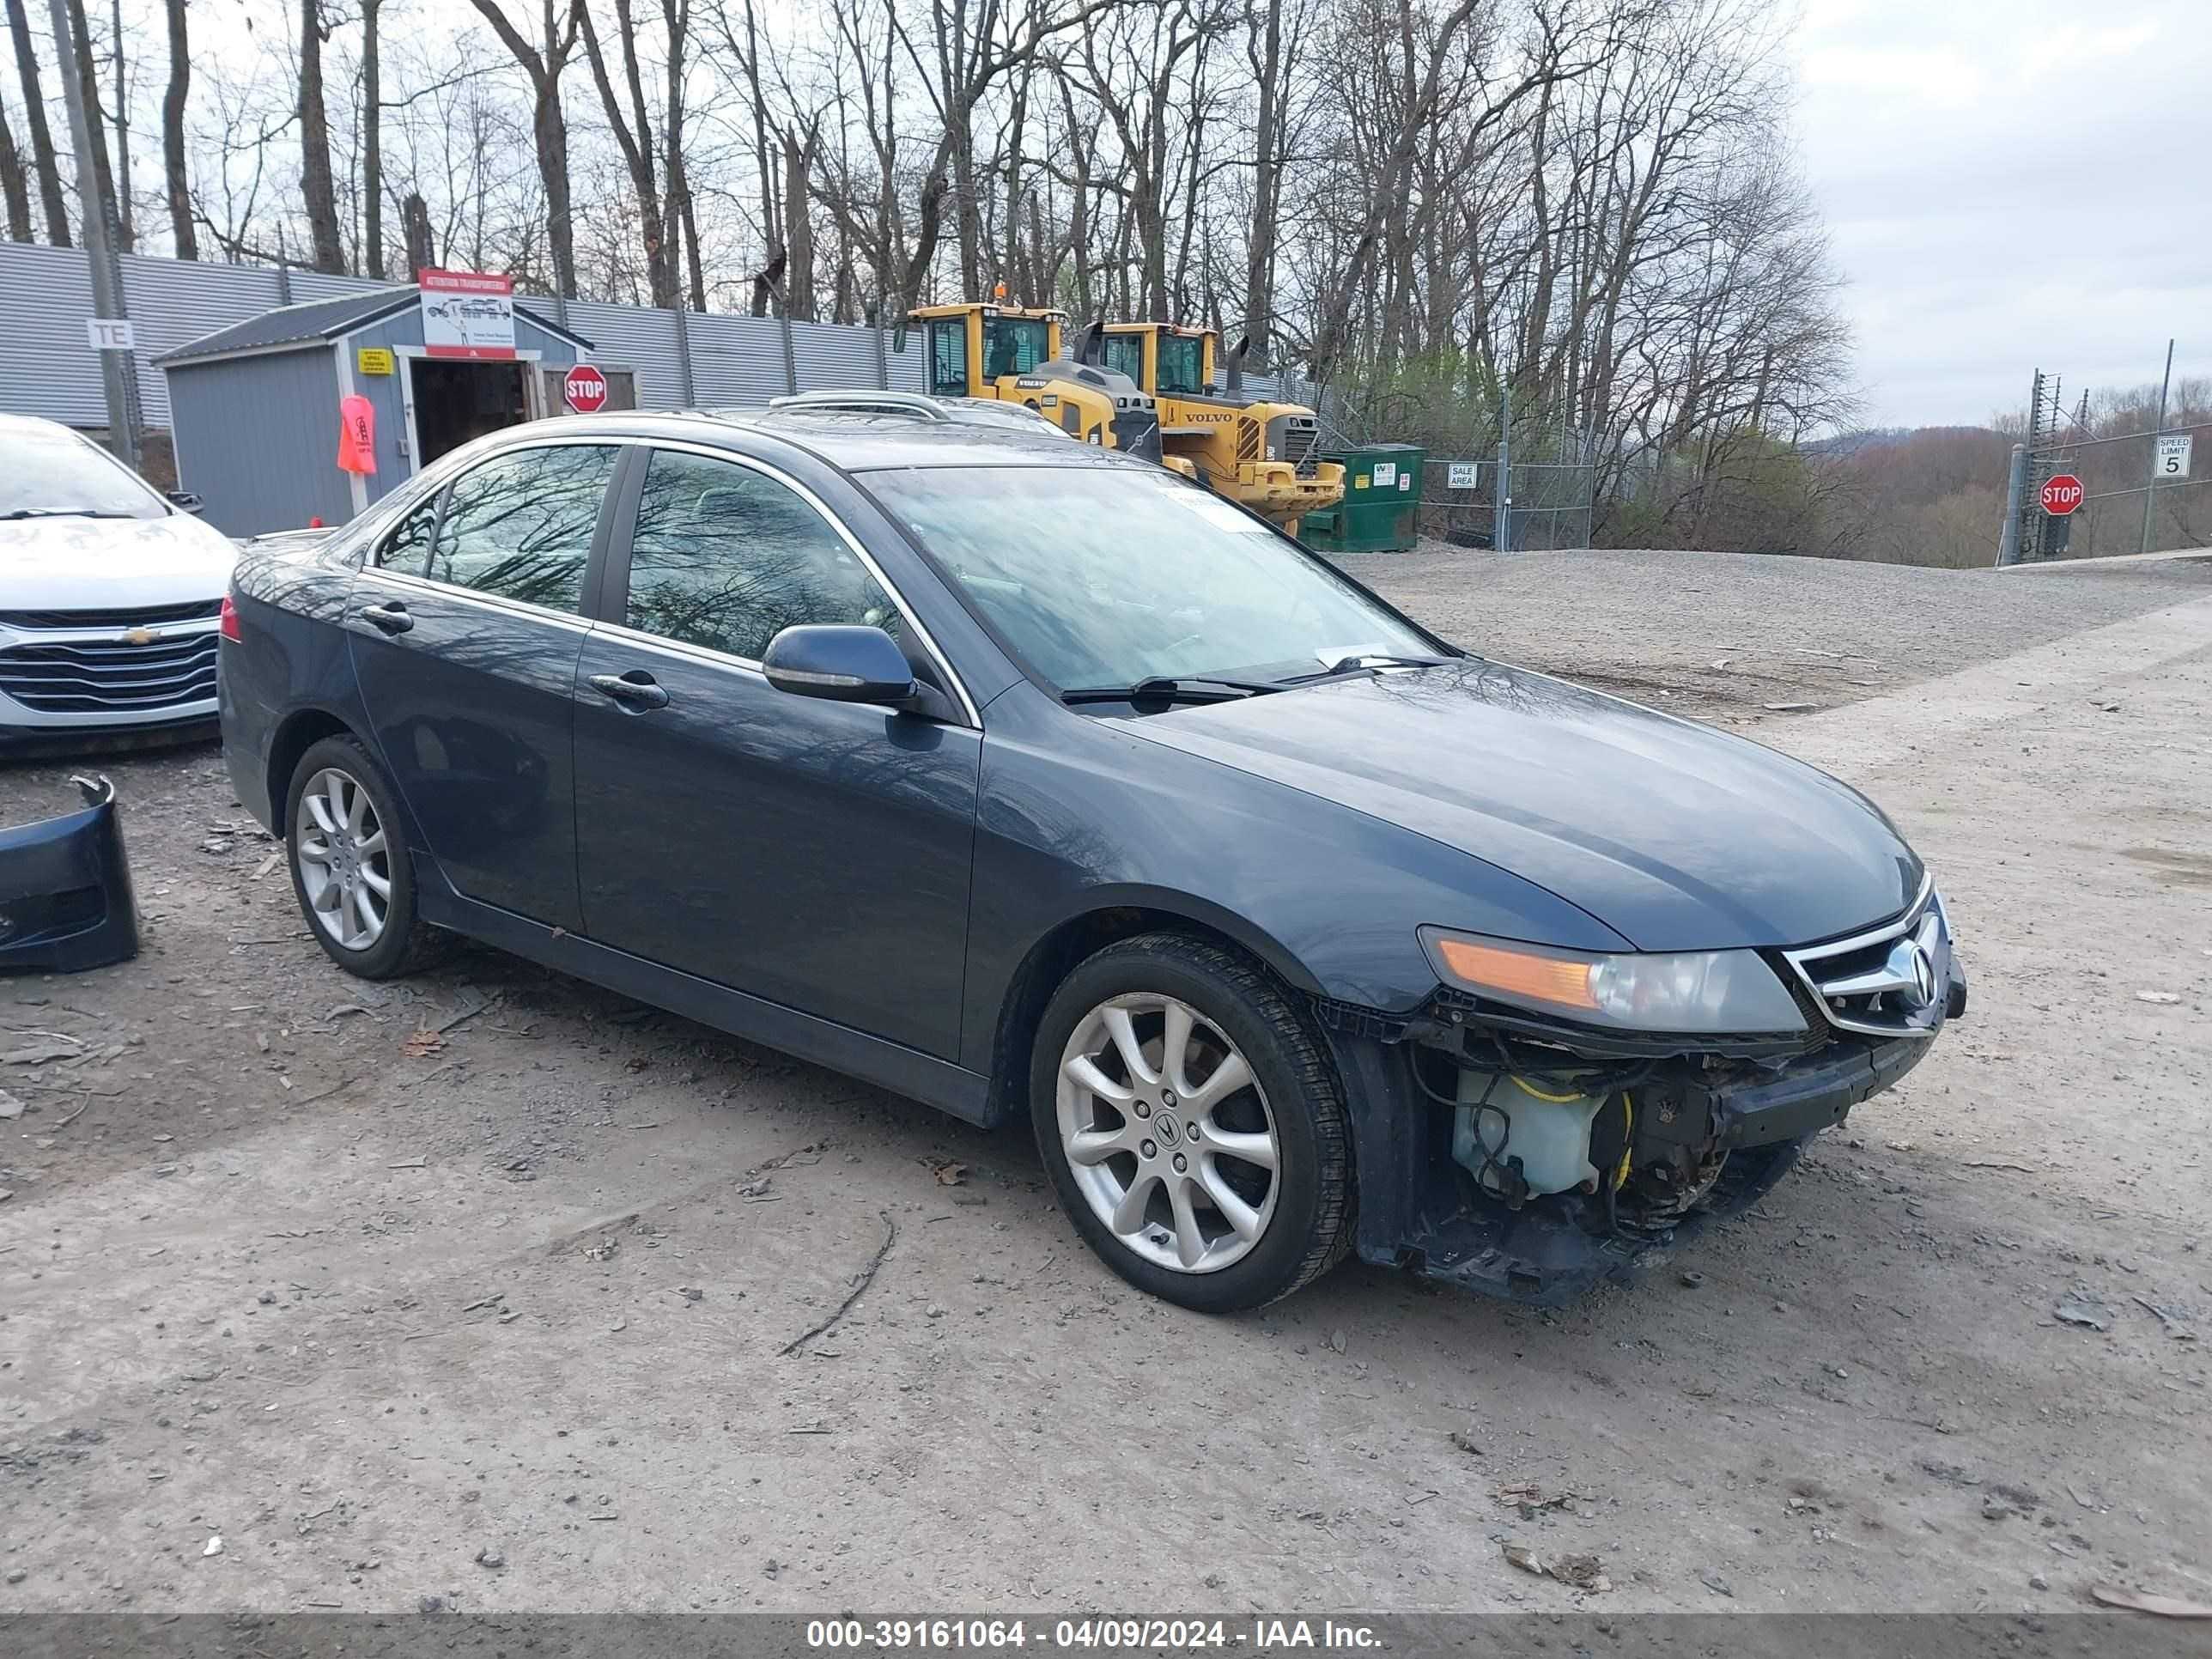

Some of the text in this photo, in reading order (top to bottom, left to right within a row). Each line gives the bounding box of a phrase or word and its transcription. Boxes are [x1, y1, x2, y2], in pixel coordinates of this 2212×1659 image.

[94, 325, 127, 344] TE
[568, 380, 604, 398] STOP
[1185, 413, 1232, 422] VOLVO
[2160, 438, 2189, 447] SPEED
[2161, 447, 2186, 455] LIMIT
[2166, 457, 2179, 473] 5
[1452, 466, 1473, 475] SALE
[1451, 477, 1473, 485] AREA
[2042, 486, 2081, 503] STOP
